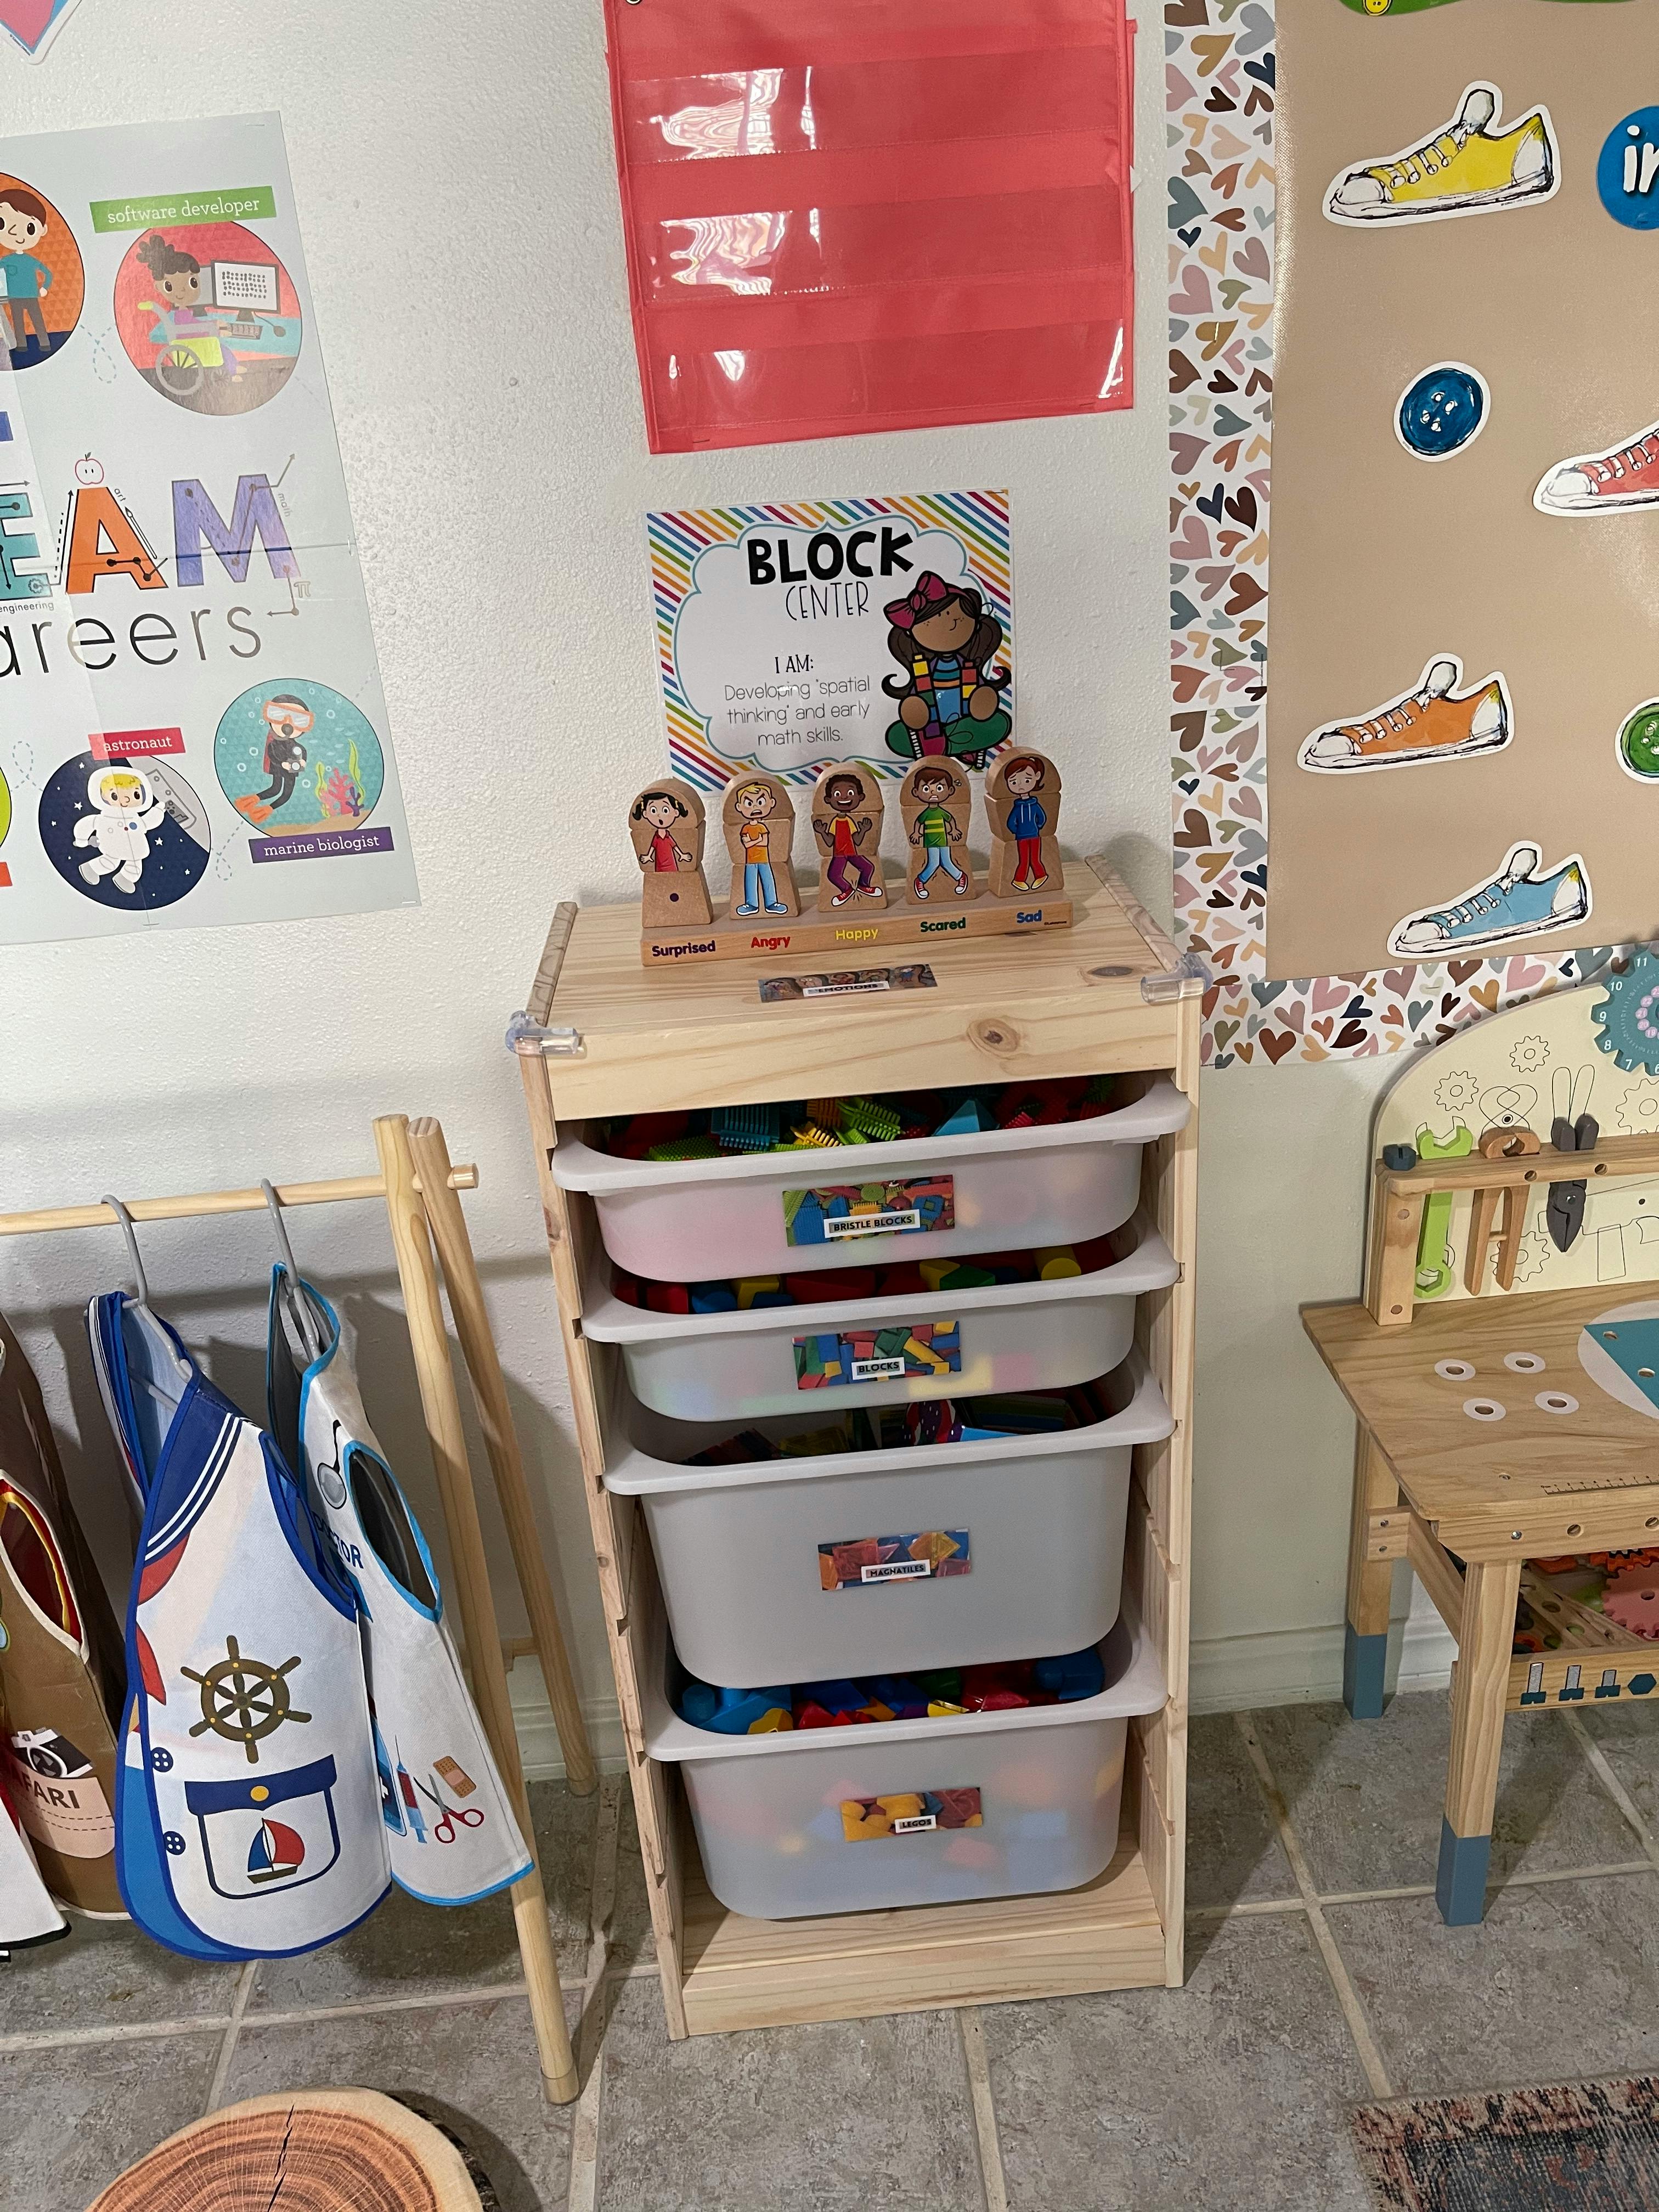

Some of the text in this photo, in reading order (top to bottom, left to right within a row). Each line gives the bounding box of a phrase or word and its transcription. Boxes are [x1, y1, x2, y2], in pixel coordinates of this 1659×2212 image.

[108, 197, 259, 223] software developer
[114, 488, 126, 501] art
[278, 493, 292, 517] math
[747, 527, 914, 585] BLOCK
[786, 581, 868, 620] CENTER
[775, 654, 814, 674] I AM:
[725, 681, 810, 701] Developing
[795, 703, 825, 720] and
[831, 700, 870, 719] early
[758, 726, 843, 746] math skills.
[103, 736, 173, 752] astronaut
[264, 836, 380, 856] marine biologist
[1017, 910, 1042, 923] Sad
[921, 917, 966, 932] Scared
[835, 928, 878, 941] Happy
[652, 940, 716, 957] Surprised
[751, 936, 791, 950] Angry
[1637, 957, 1647, 967] 11
[819, 984, 878, 993] EMOTIONS
[1611, 981, 1623, 991] 10
[1599, 1011, 1607, 1022] 9
[1604, 1039, 1612, 1051] 8
[1626, 1059, 1633, 1070] 7
[834, 1216, 913, 1231] BRISTLE BLOCKS
[859, 1362, 900, 1373] BLOCKS
[870, 1565, 924, 1577] MAGNATILES
[902, 1819, 932, 1828] LEGOS
